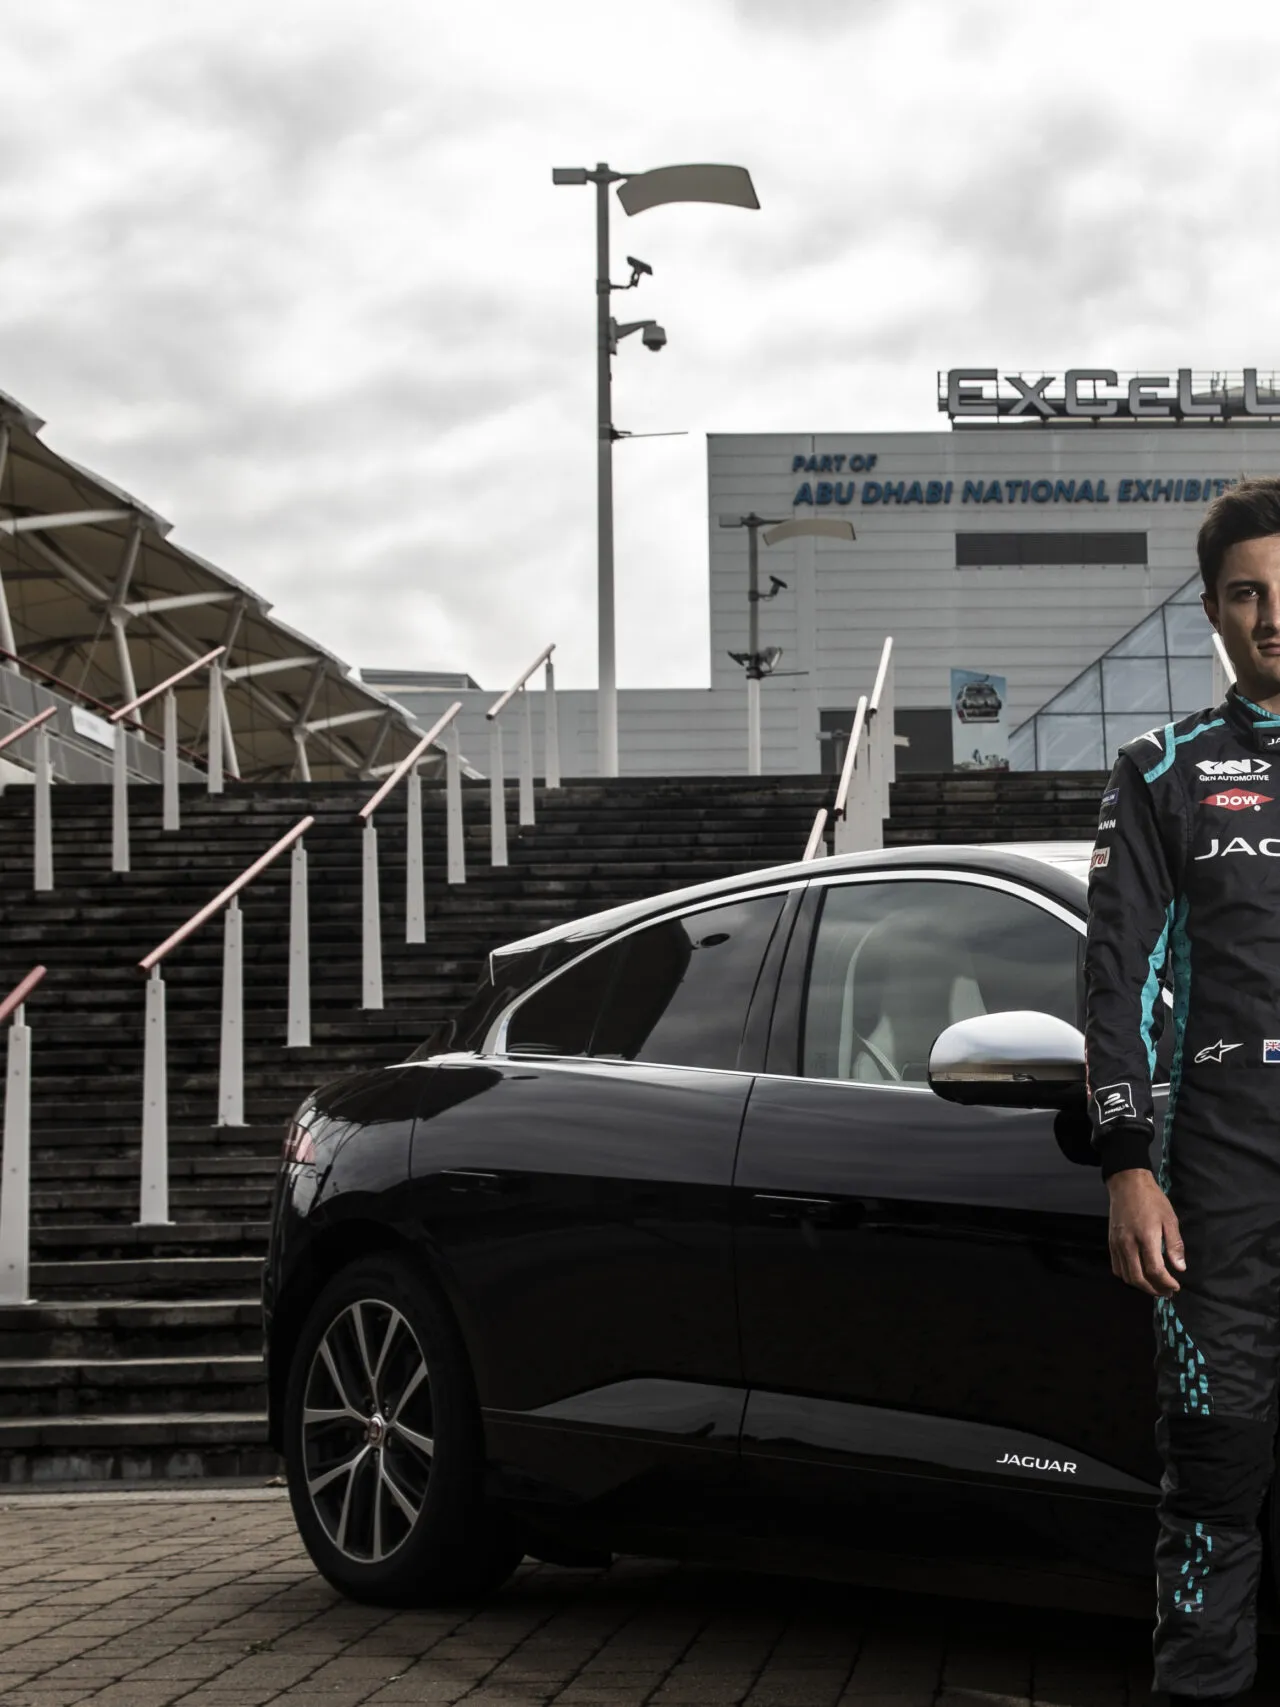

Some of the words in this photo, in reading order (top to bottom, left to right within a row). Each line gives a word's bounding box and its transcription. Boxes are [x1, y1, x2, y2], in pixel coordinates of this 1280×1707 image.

[792, 454, 846, 473] PART
[849, 454, 877, 473] OF
[792, 481, 855, 505] ABU
[860, 481, 954, 504] DHABI
[961, 479, 1110, 503] NATIONAL
[1199, 774, 1217, 782] GKN
[1217, 774, 1270, 782] AUTOMOTIVE
[996, 1453, 1077, 1474] JAGUAR
